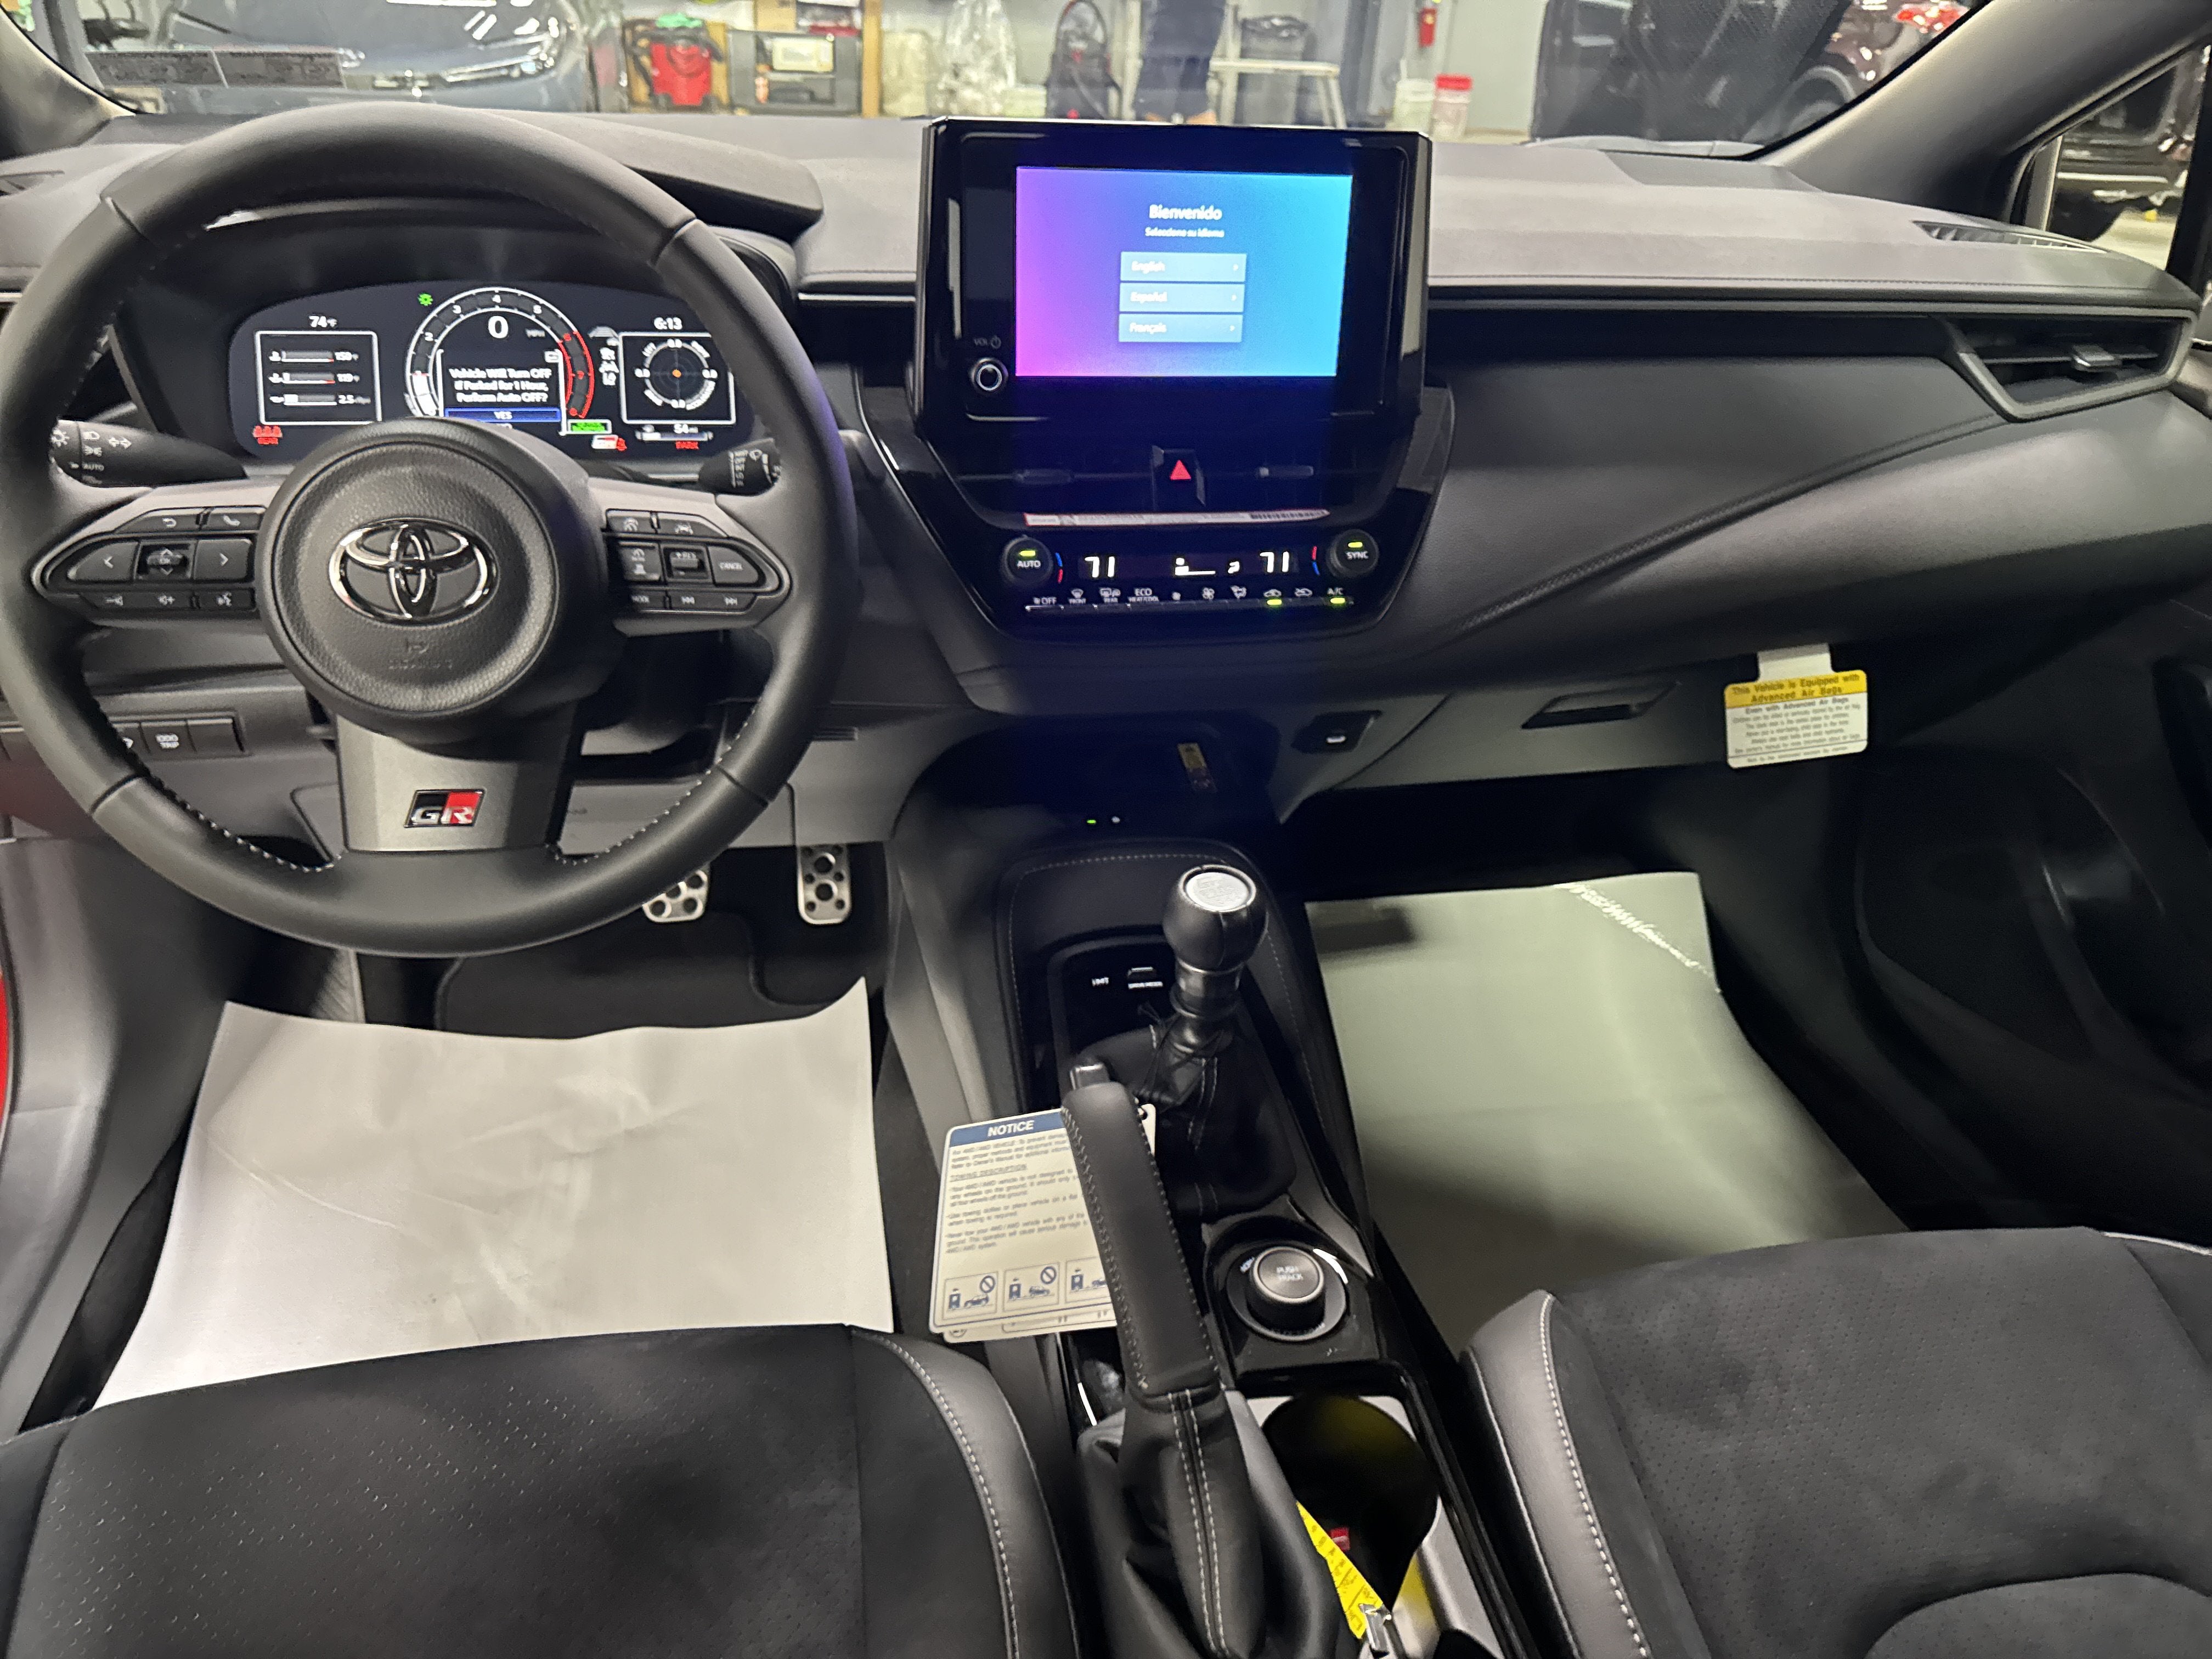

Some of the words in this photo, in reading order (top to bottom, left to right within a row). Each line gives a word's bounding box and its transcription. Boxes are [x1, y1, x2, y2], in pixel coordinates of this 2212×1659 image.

[1149, 204, 1223, 221] Bienvenido
[1131, 261, 1166, 274] English
[492, 294, 501, 303] 4
[1130, 291, 1167, 304] Español
[452, 304, 462, 314] 3
[533, 304, 542, 314] 5
[487, 315, 509, 339] 0
[653, 317, 682, 330] 6:13
[1129, 322, 1167, 335] Français
[424, 331, 435, 342] 2
[448, 368, 487, 379] Vehicle
[486, 368, 508, 379] Will
[507, 368, 531, 379] Turn
[530, 368, 552, 379] OFF
[464, 380, 498, 391] Parked
[498, 380, 514, 391] for
[456, 392, 496, 403] Perform
[496, 392, 522, 403] Auto
[521, 392, 549, 403] OFF?
[493, 411, 514, 420] YES
[1345, 551, 1369, 560] SYNC
[1016, 560, 1042, 569] AUTO
[1084, 556, 1116, 578] 71
[1260, 551, 1290, 574] 71
[1133, 587, 1153, 597] ECO
[1327, 588, 1344, 596] A/C
[1041, 596, 1057, 605] OFF
[1731, 686, 1751, 694] This
[1754, 682, 1785, 692] Vehicle
[1799, 675, 1839, 687] Equipped
[1842, 673, 1860, 682] with
[1751, 691, 1796, 703] Advanced
[1802, 689, 1815, 697] Air
[1820, 686, 1843, 696] Bags
[1783, 701, 1816, 710] Advanced
[410, 805, 475, 825] GR
[987, 1119, 1035, 1138] NOTICE
